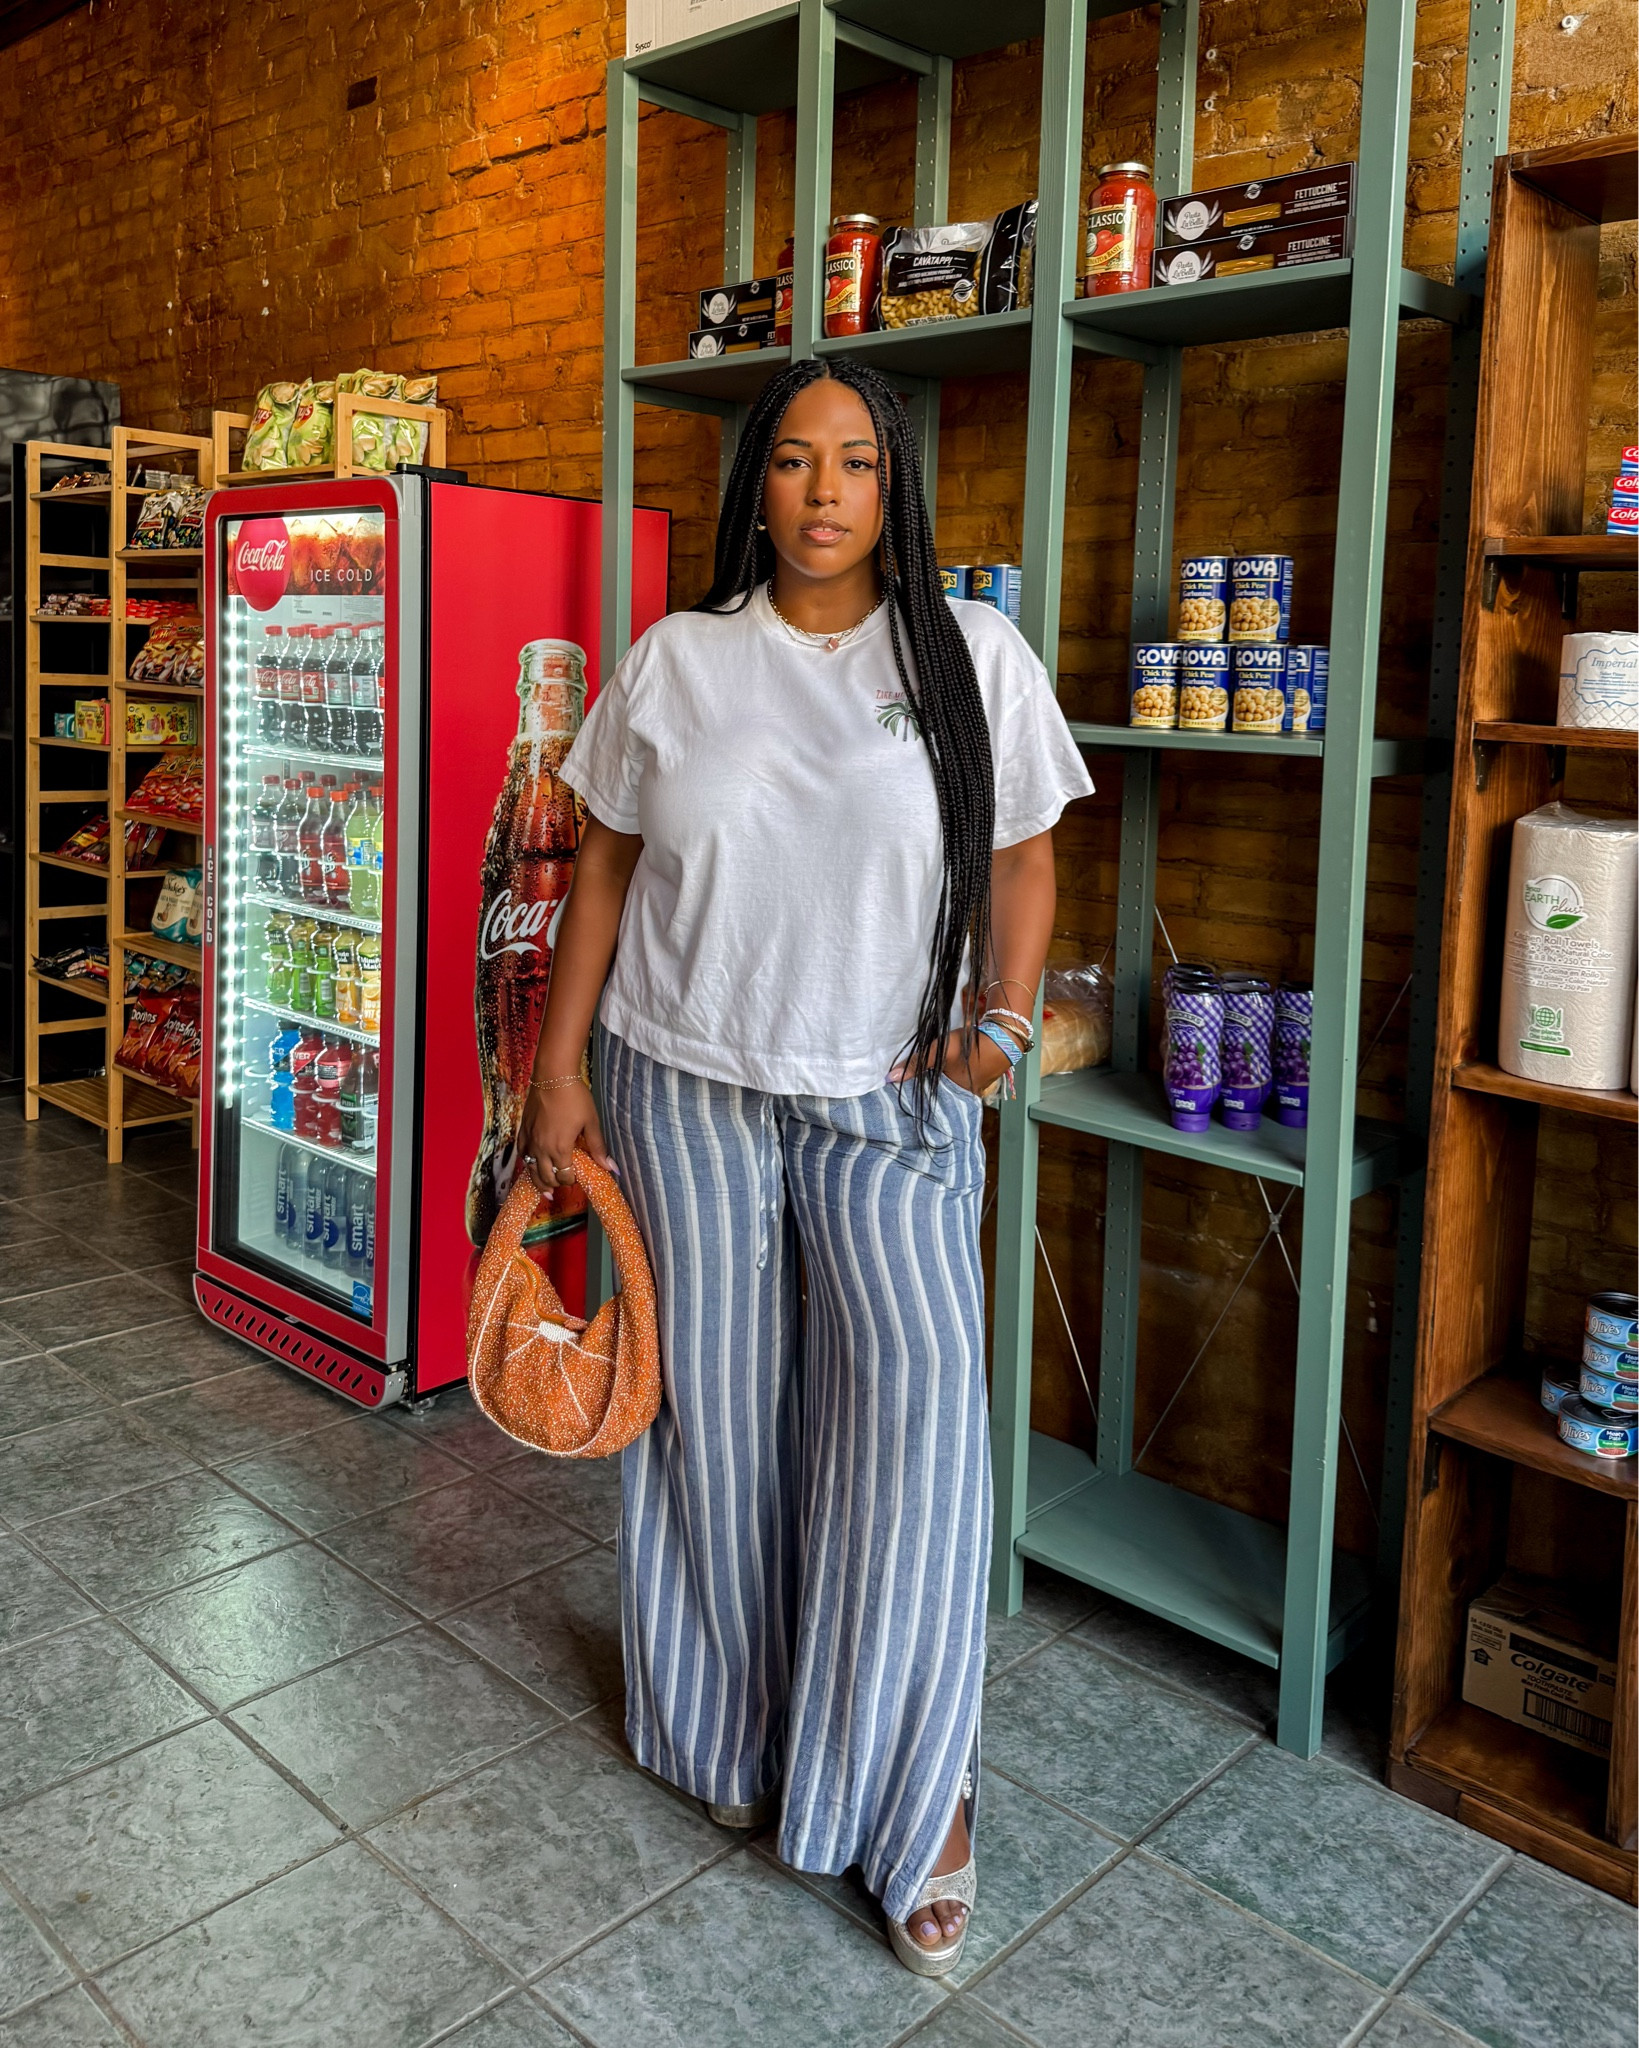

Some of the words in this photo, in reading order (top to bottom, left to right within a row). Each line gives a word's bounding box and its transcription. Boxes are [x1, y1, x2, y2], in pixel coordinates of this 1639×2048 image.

[635, 41, 651, 52] Sysco
[1295, 182, 1337, 200] FETTUCCINE
[1288, 235, 1331, 252] FETTUCCINE
[237, 540, 288, 572] Coca-Cola
[310, 569, 331, 582] ICE
[337, 568, 373, 582] COLD
[1591, 657, 1637, 670] Imperial
[876, 689, 892, 700] TAKE
[1525, 892, 1560, 905] EARTH
[1547, 897, 1581, 917] plus
[1544, 935, 1561, 946] Roll
[1564, 937, 1599, 949] Towels
[352, 1203, 364, 1251] smart
[1511, 1653, 1590, 1694] Colgate
[1527, 1674, 1574, 1697] TOOTHPASTE
